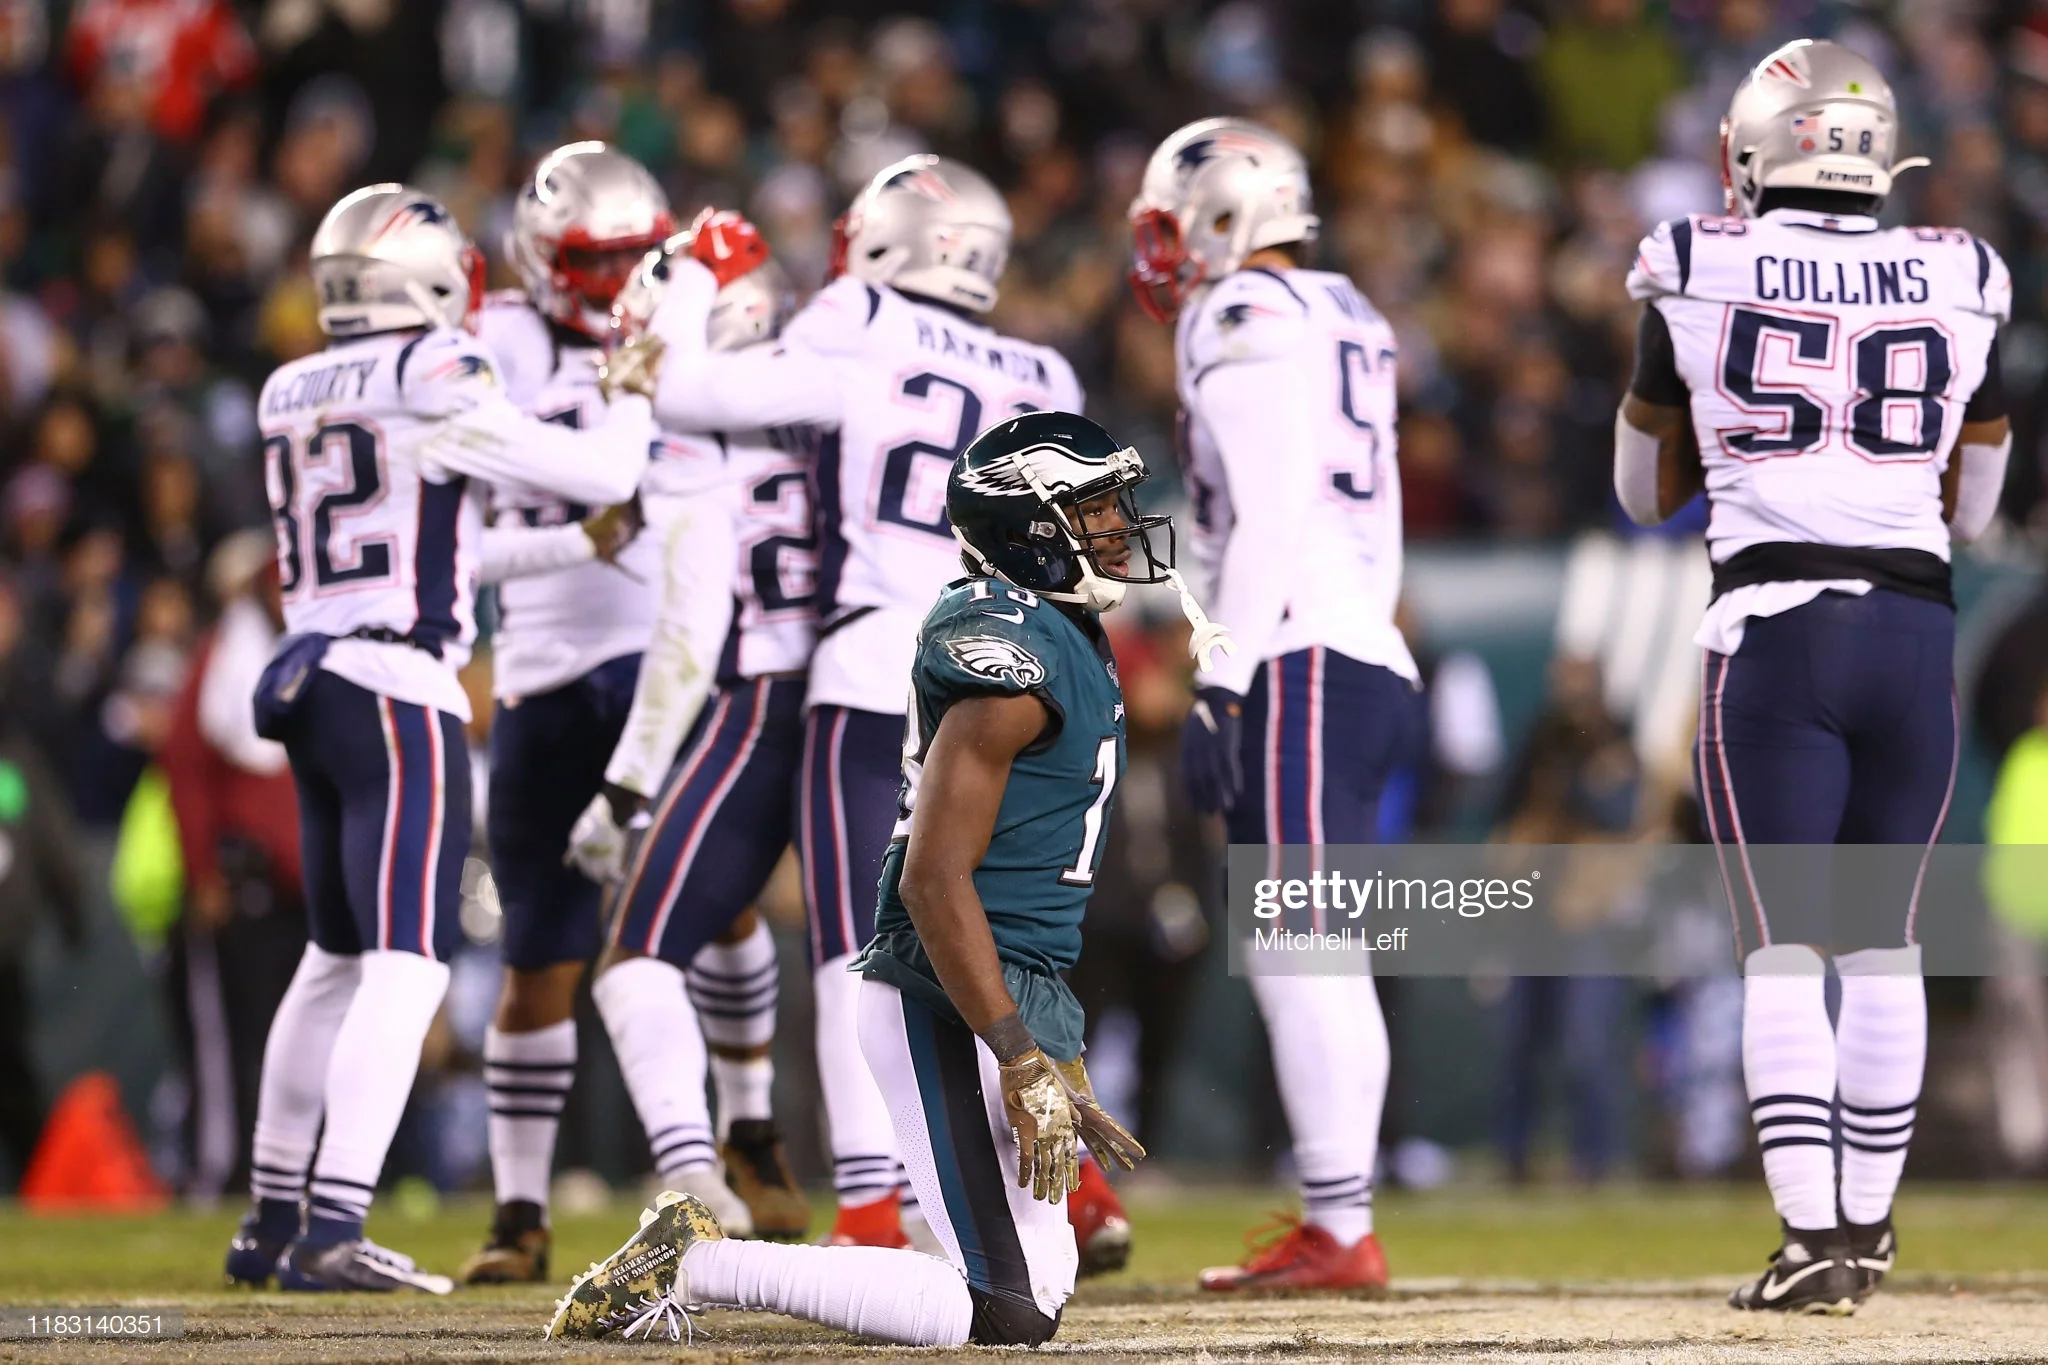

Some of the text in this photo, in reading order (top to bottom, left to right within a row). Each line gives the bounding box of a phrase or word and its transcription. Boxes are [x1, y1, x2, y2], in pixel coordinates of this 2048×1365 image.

[1755, 255, 1930, 305] COLLINS
[1716, 302, 1958, 464] 58
[613, 1243, 669, 1276] WHO SERVED
[613, 1247, 677, 1287] HONORING ALL
